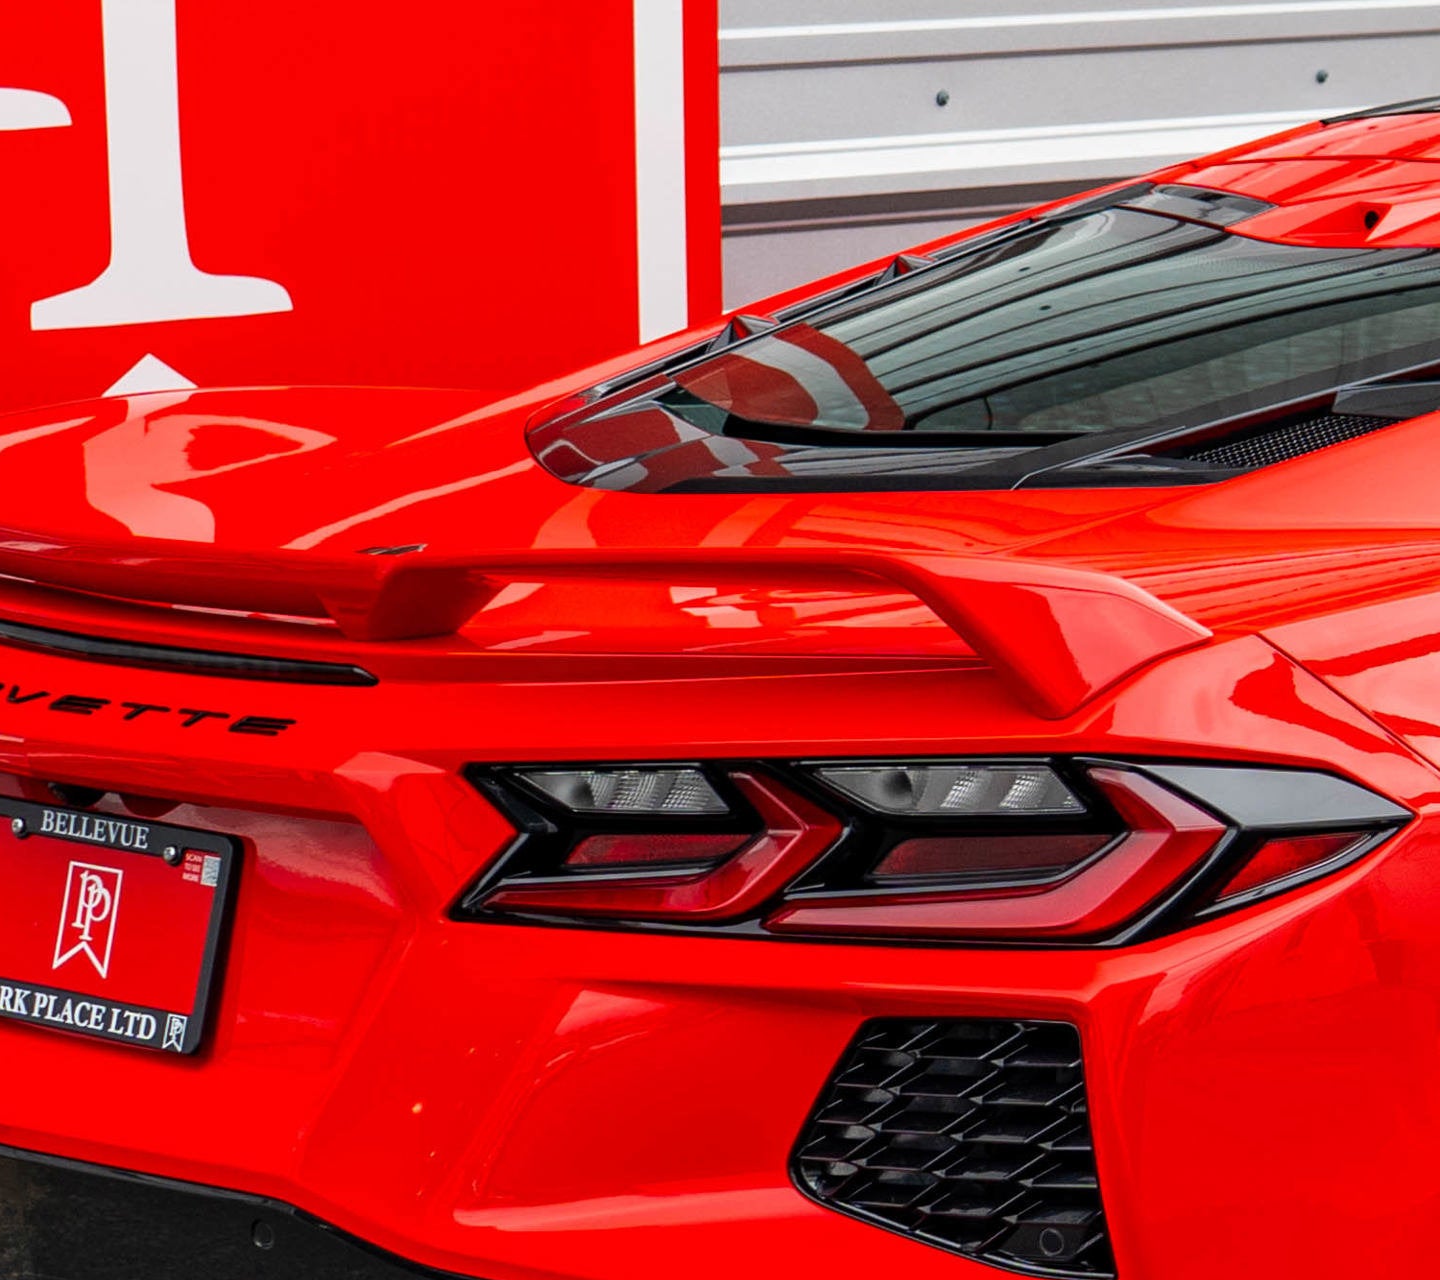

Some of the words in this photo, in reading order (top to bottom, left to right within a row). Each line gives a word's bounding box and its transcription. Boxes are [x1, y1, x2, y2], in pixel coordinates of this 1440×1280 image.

[40, 809, 149, 849] BELLEVUE
[31, 991, 106, 1031] PLACE
[108, 1007, 157, 1040] LTD
